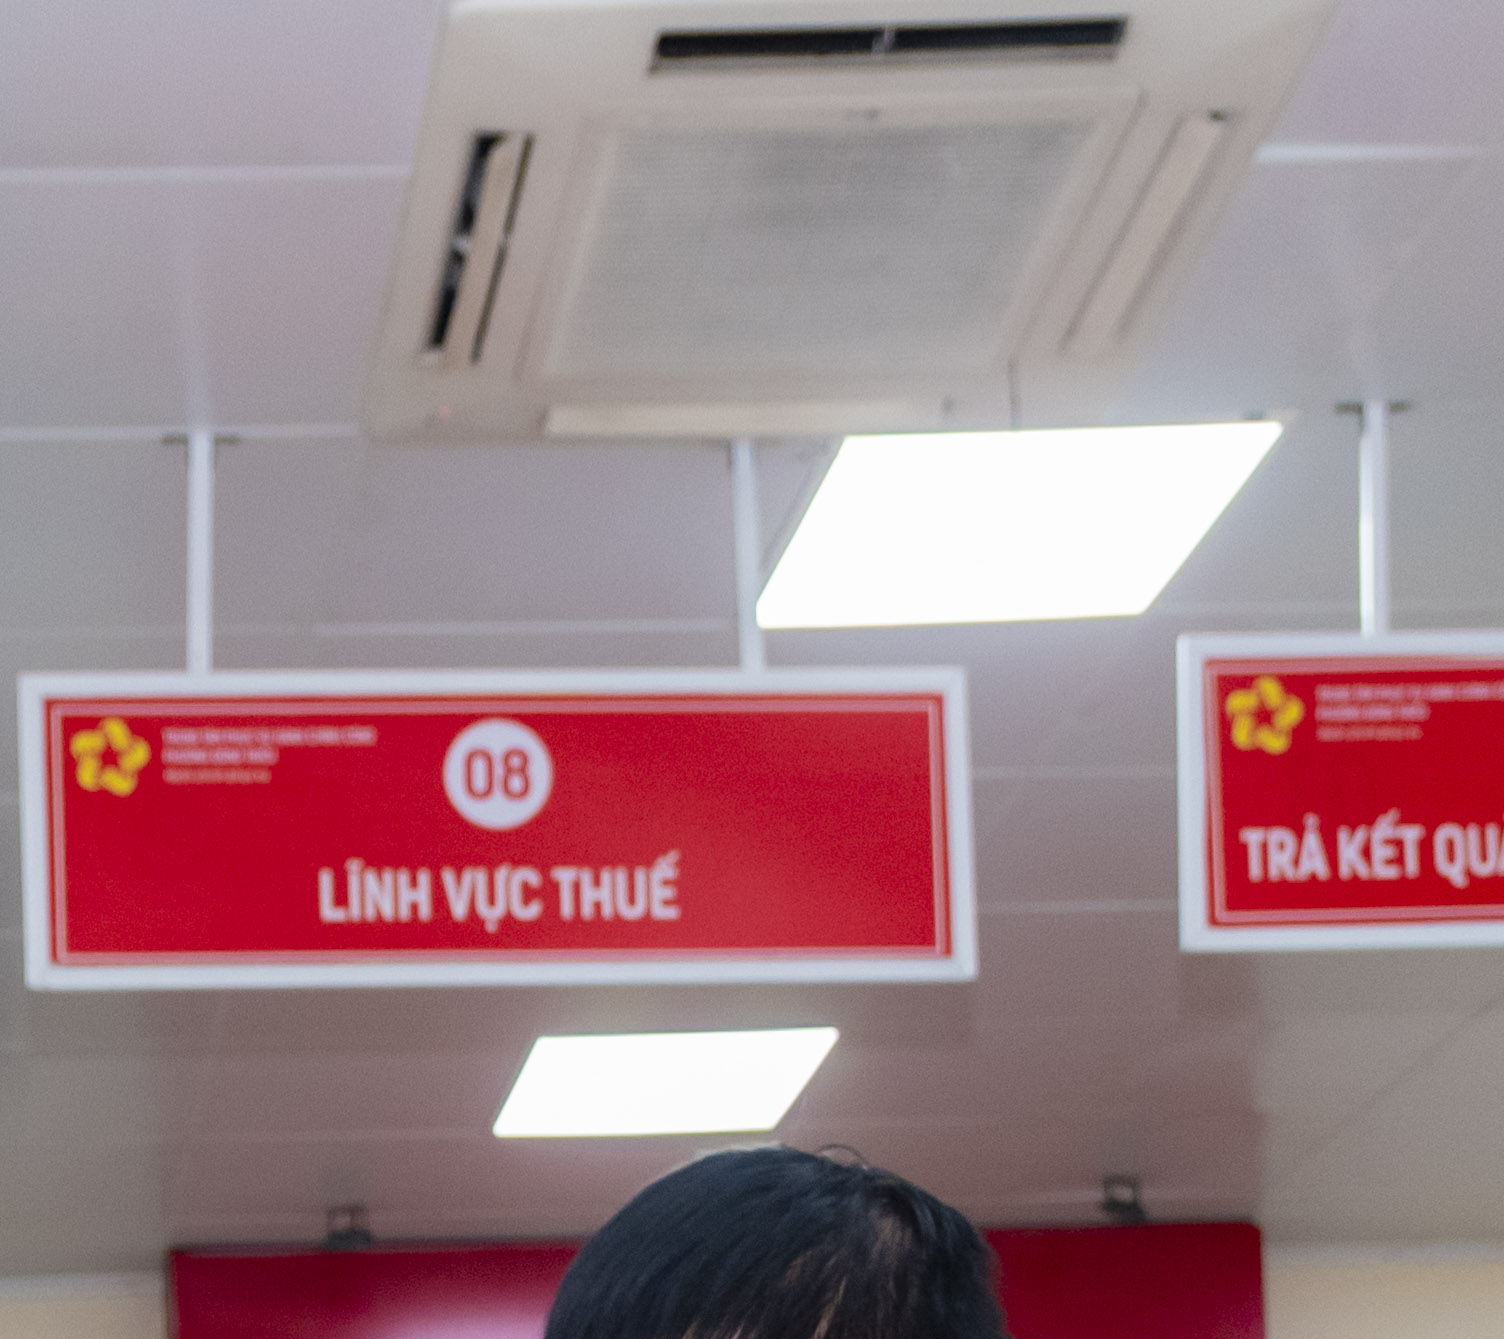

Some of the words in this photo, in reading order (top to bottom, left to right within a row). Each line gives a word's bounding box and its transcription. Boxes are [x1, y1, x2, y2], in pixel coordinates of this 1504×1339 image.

[462, 747, 532, 802] 08
[1240, 814, 1332, 884] TRẢ
[1336, 808, 1425, 881] KẾT
[317, 858, 432, 923] LĨNH
[440, 866, 544, 932] VỰC
[552, 850, 682, 922] THUẾ
